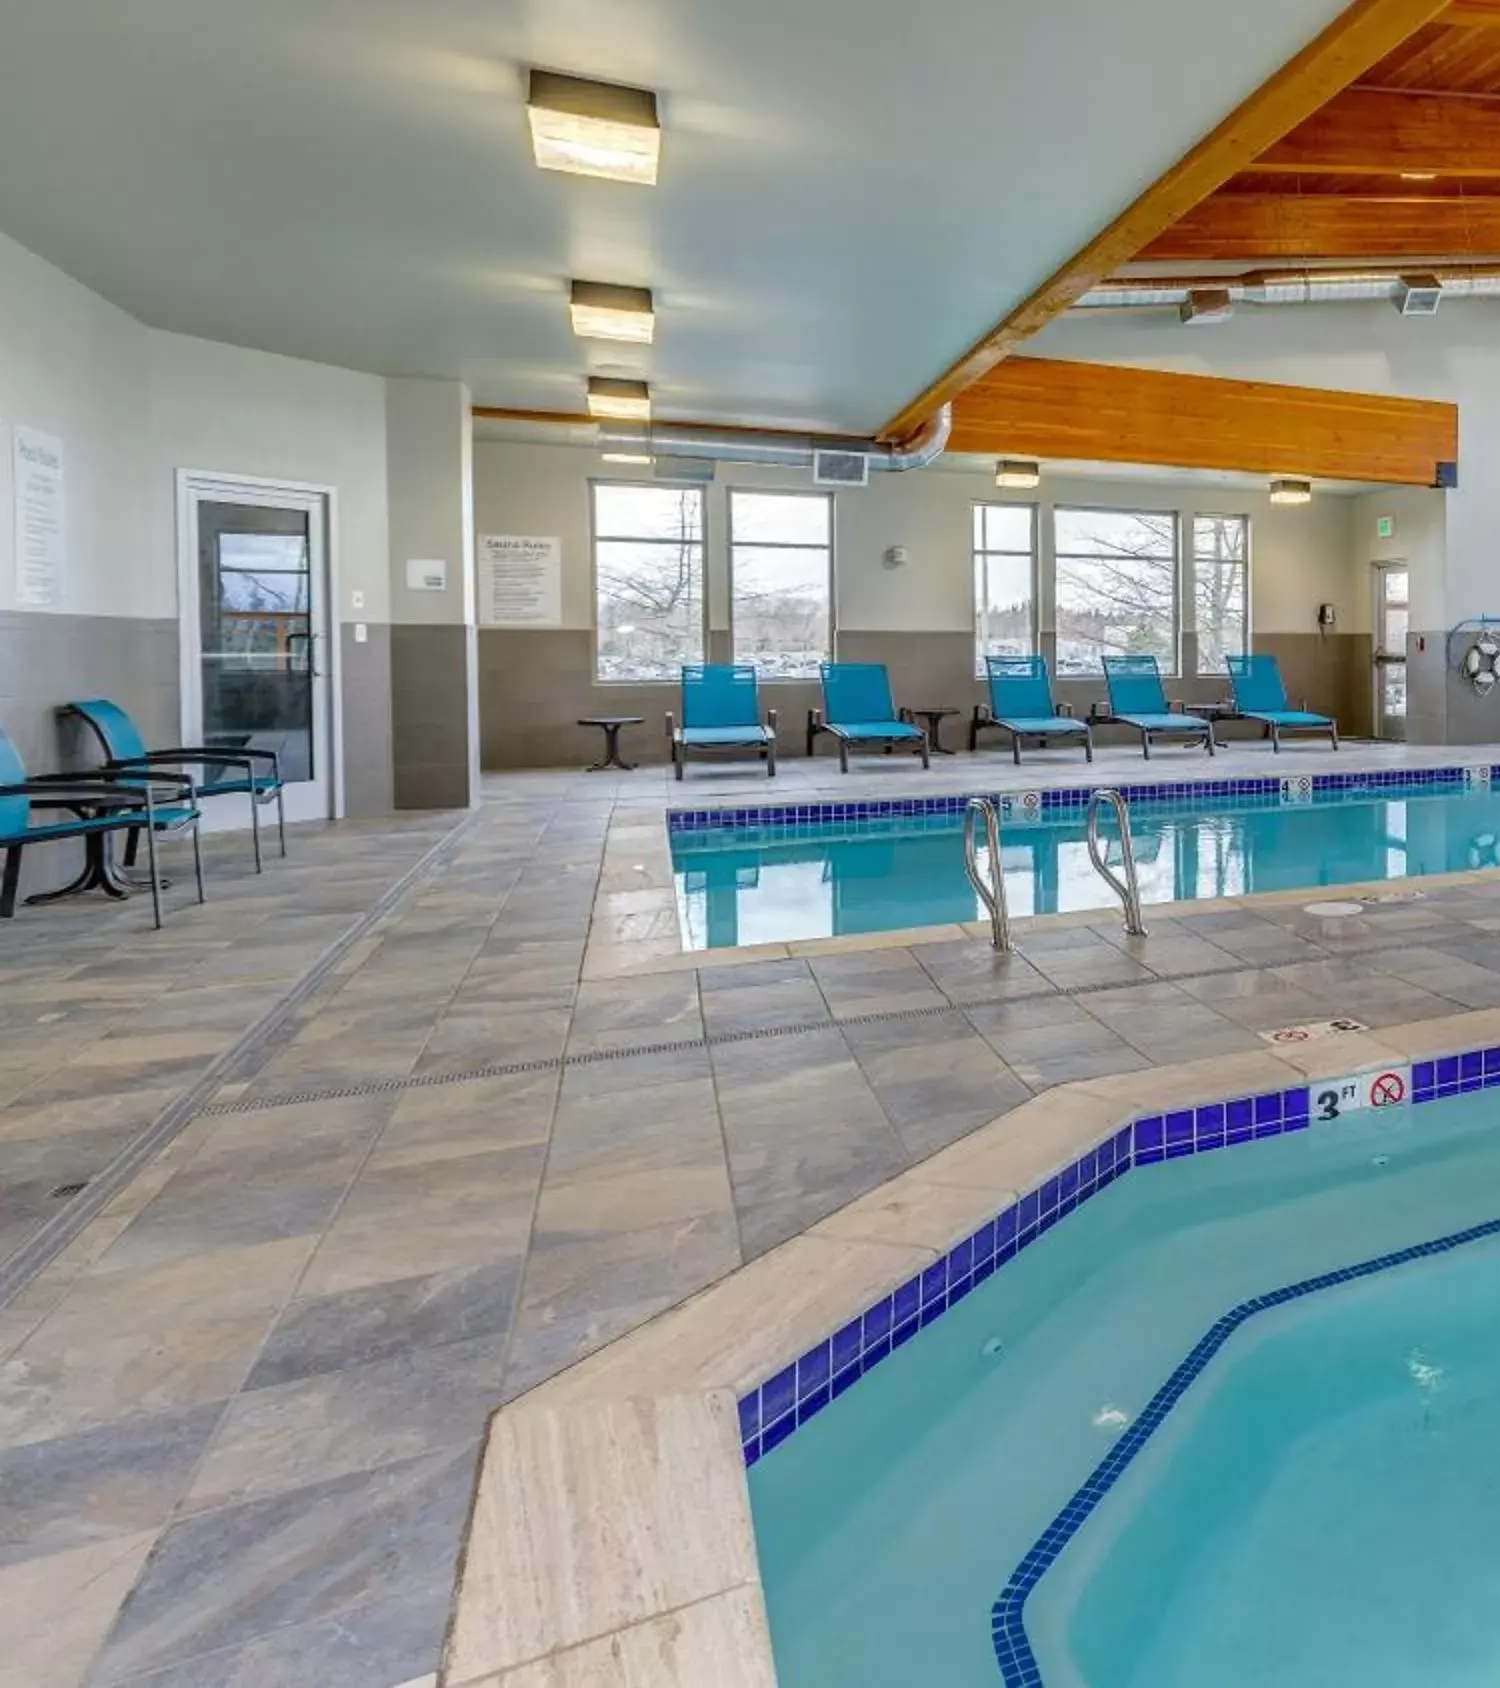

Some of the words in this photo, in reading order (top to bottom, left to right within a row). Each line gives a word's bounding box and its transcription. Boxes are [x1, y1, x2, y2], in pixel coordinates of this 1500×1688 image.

[1281, 779, 1289, 792] 4
[1317, 1090, 1340, 1121] 3
[1341, 1085, 1357, 1100] FT
